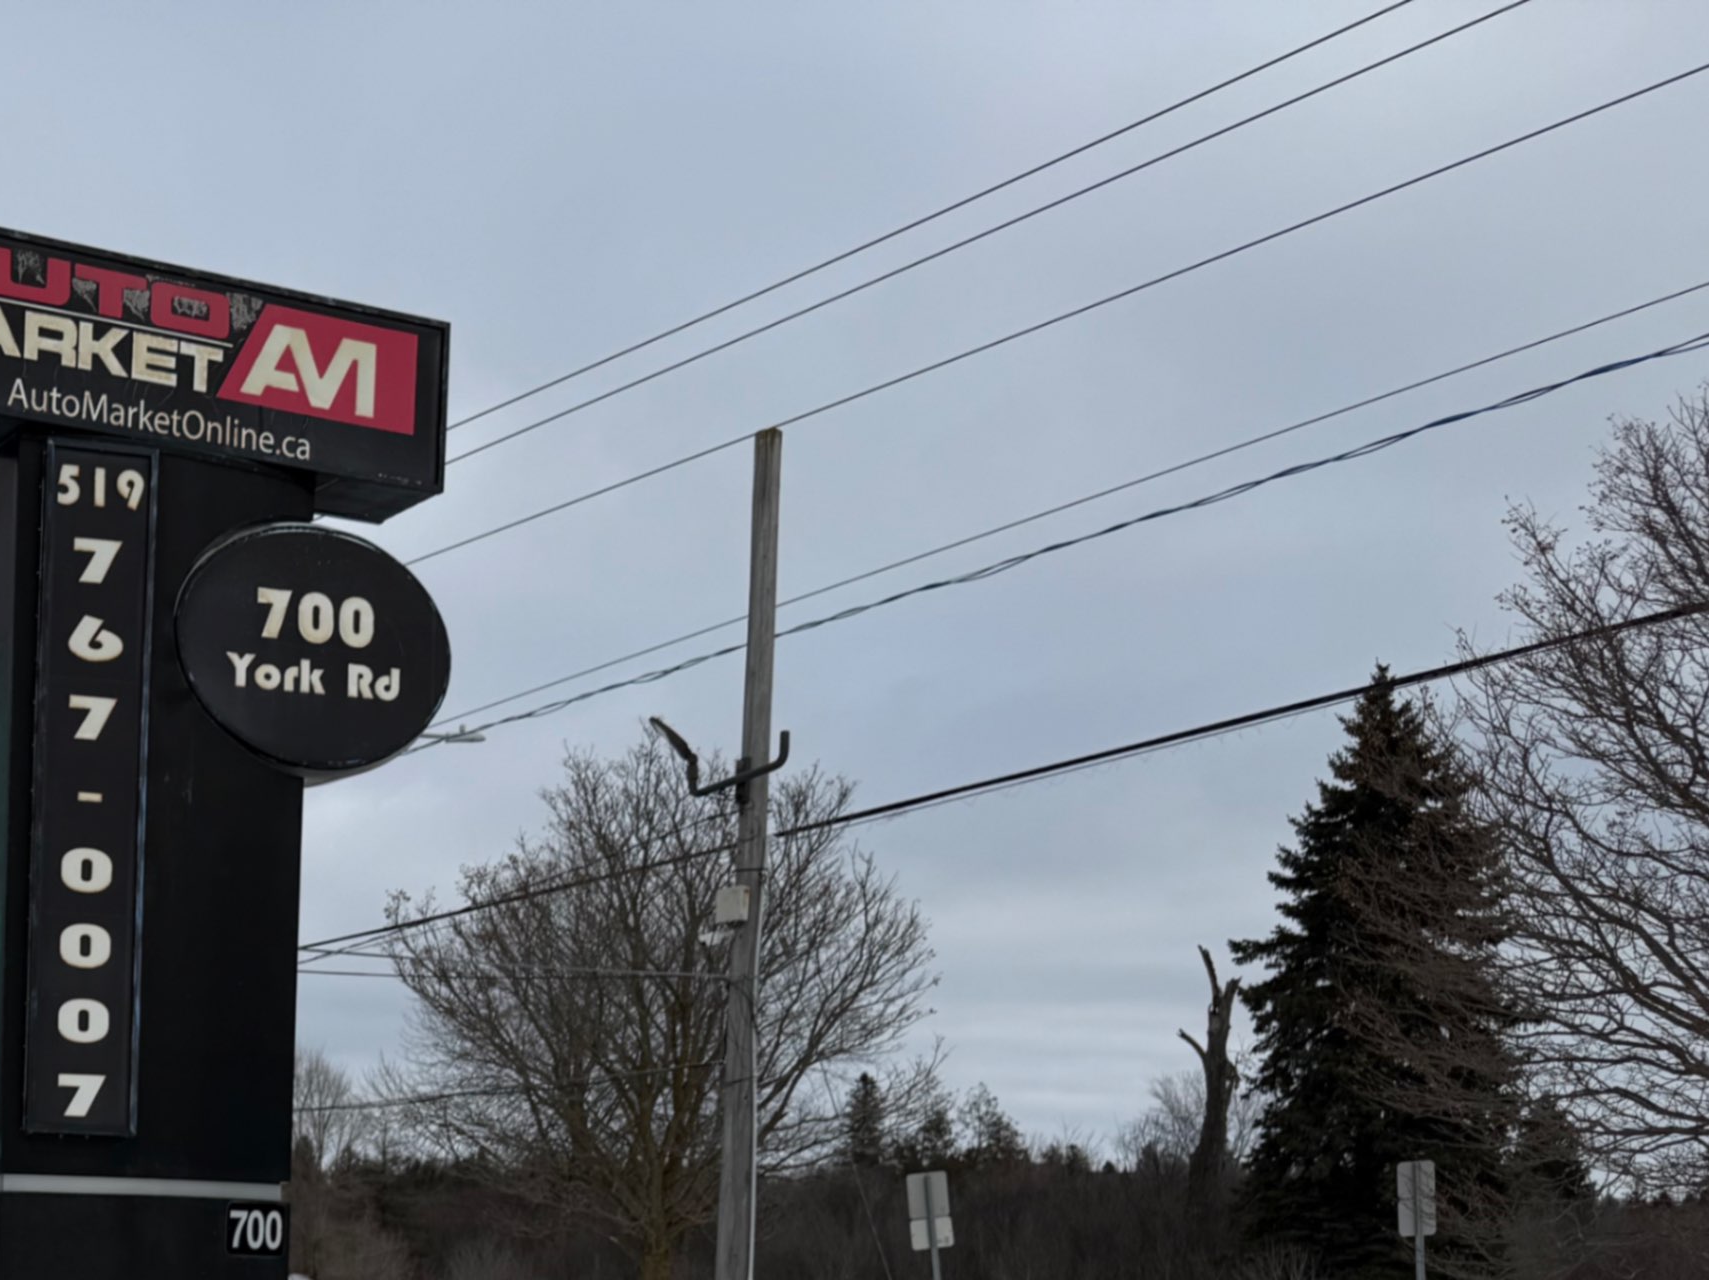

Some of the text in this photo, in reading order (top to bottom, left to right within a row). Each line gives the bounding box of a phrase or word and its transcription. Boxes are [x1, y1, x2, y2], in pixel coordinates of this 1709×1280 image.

[7, 377, 312, 461] AutoMarketOnline.ca
[57, 464, 145, 510] 519
[257, 587, 375, 649] 700
[226, 651, 402, 701] York Rd
[229, 1209, 282, 1250] 700
